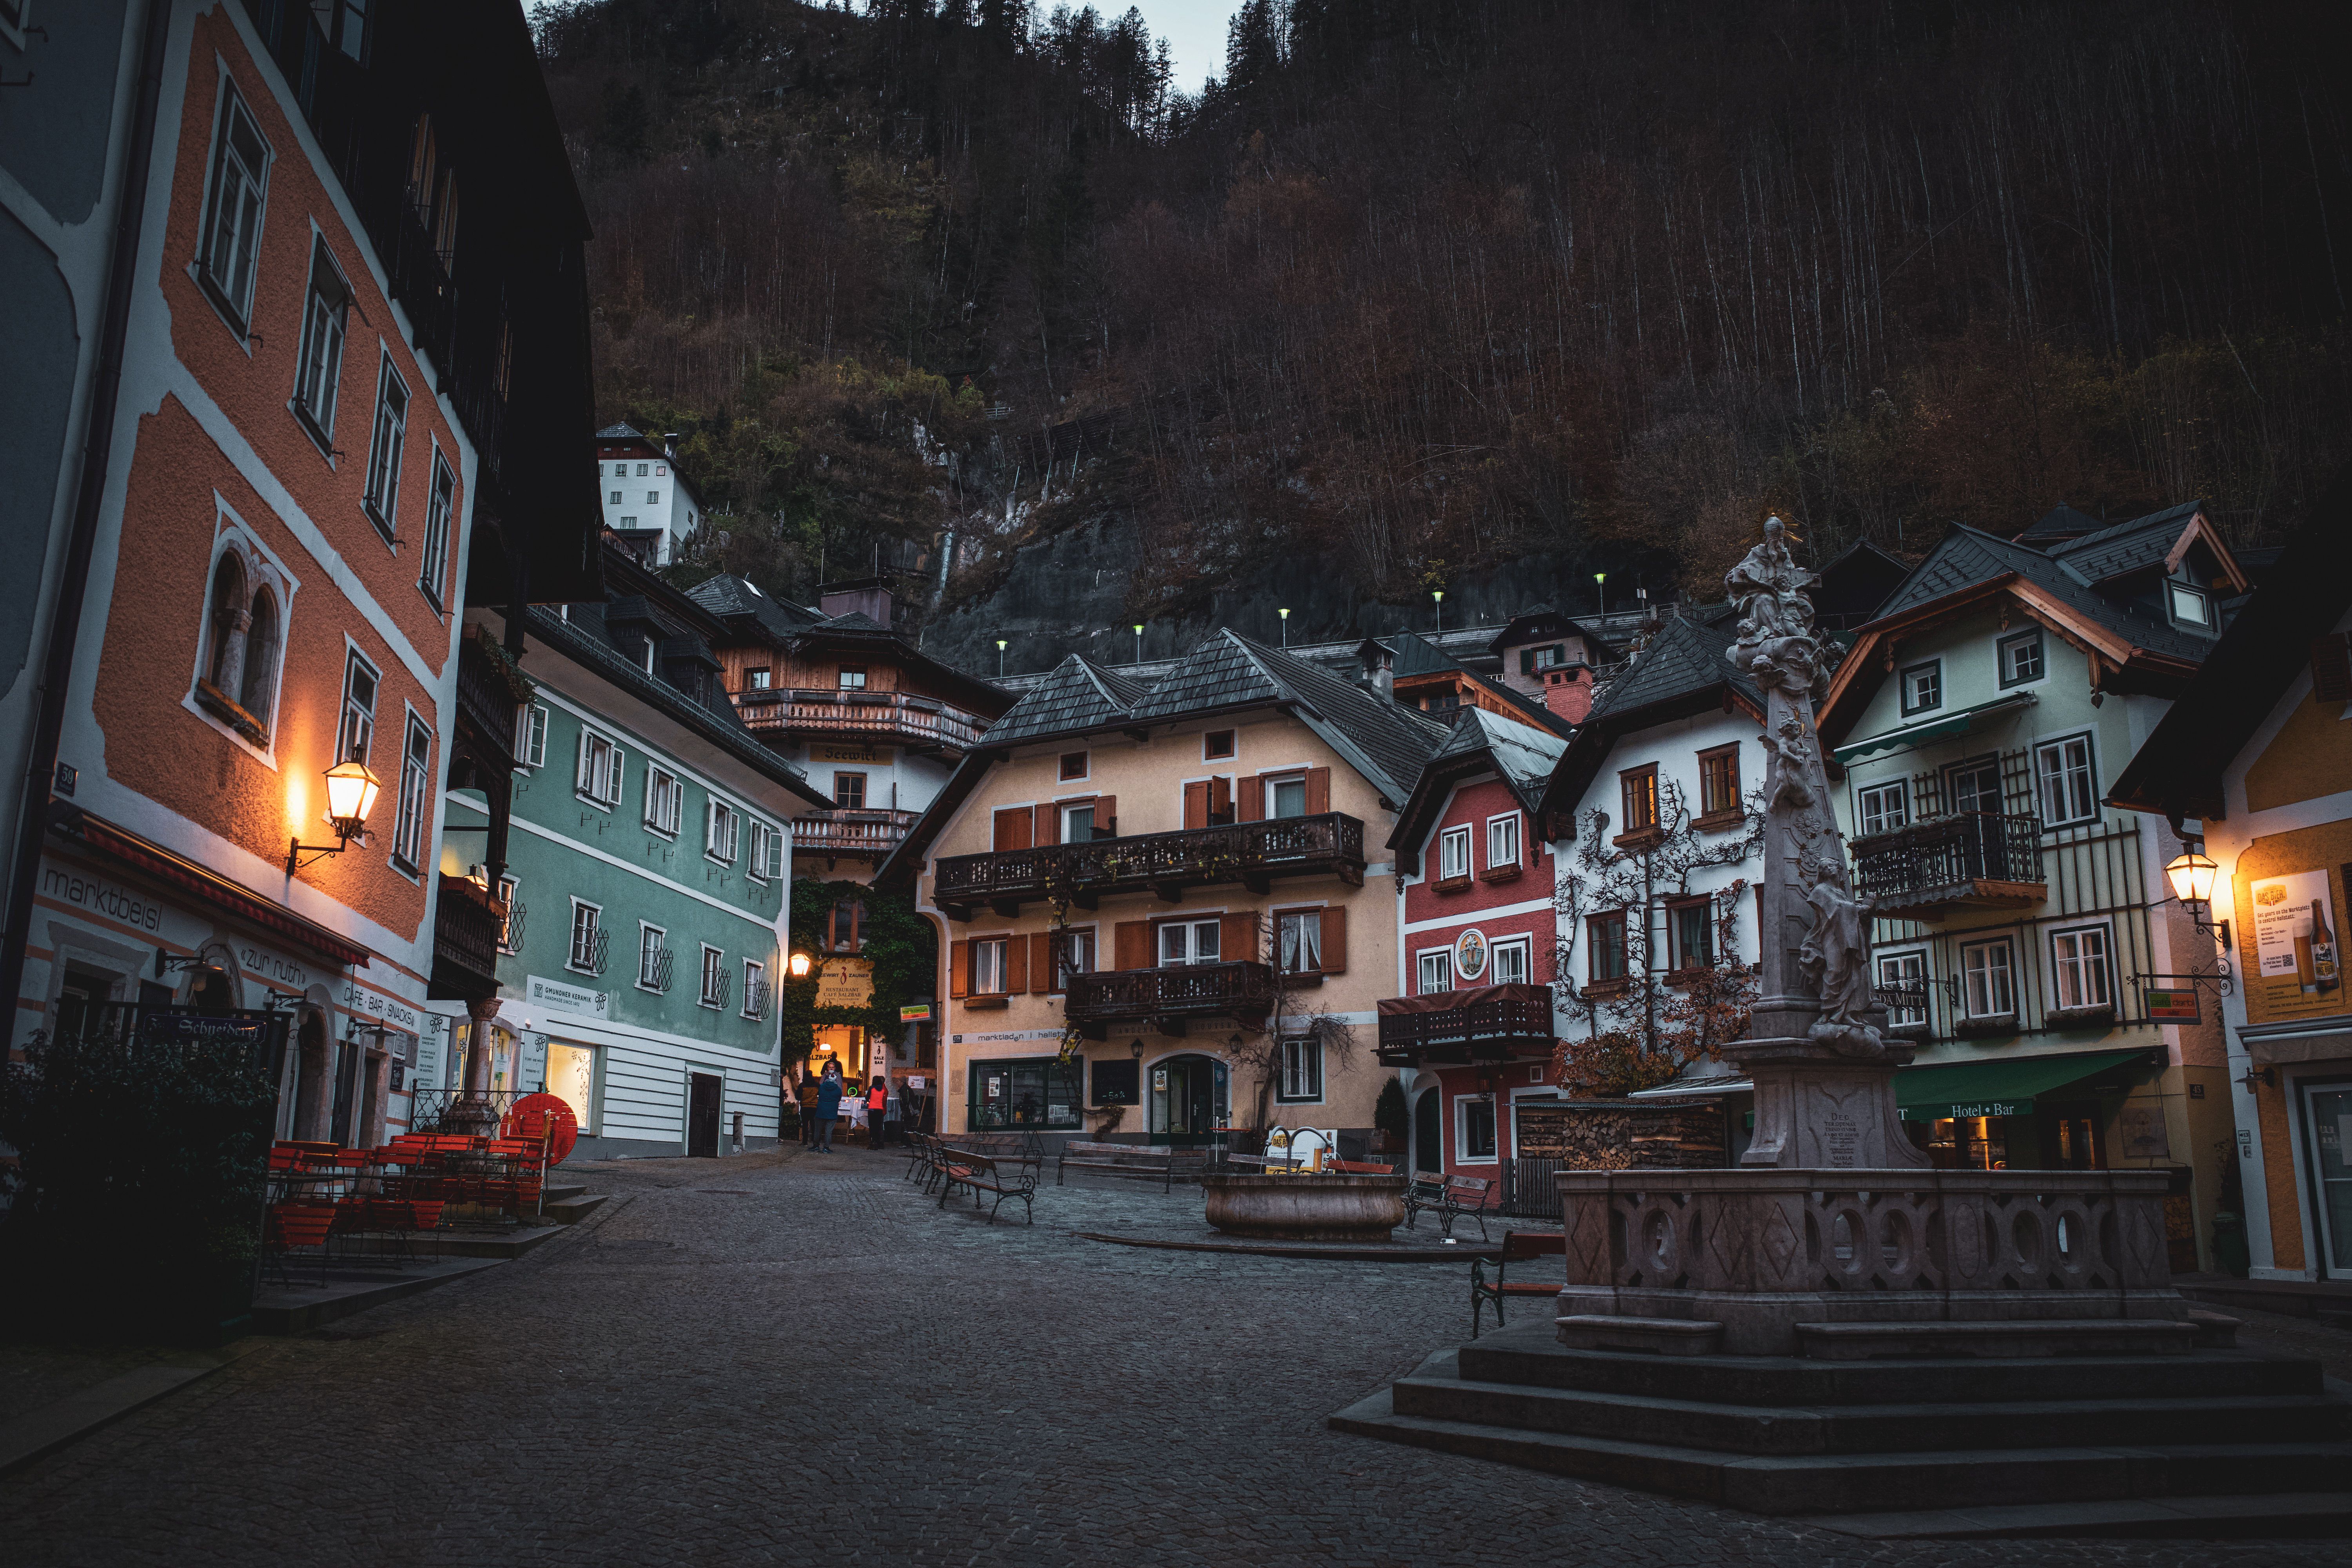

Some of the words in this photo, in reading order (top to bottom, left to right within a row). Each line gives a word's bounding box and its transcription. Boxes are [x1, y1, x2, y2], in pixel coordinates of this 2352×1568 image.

[825, 746, 877, 761] Seewirt
[62, 766, 74, 784] 59
[44, 867, 163, 932] marktbeisl
[2258, 892, 2269, 902] DAS
[545, 987, 571, 998] GMUNDNER
[572, 993, 592, 1003] KERAMIK
[1895, 992, 1924, 1006] MITT
[345, 987, 364, 1006] CAFÉ
[369, 996, 384, 1013] BAR
[388, 1003, 412, 1025] SNACKS
[978, 1033, 1024, 1042] marktladen
[1952, 1104, 1982, 1118] Hotel
[1993, 1103, 2014, 1116] Bar
